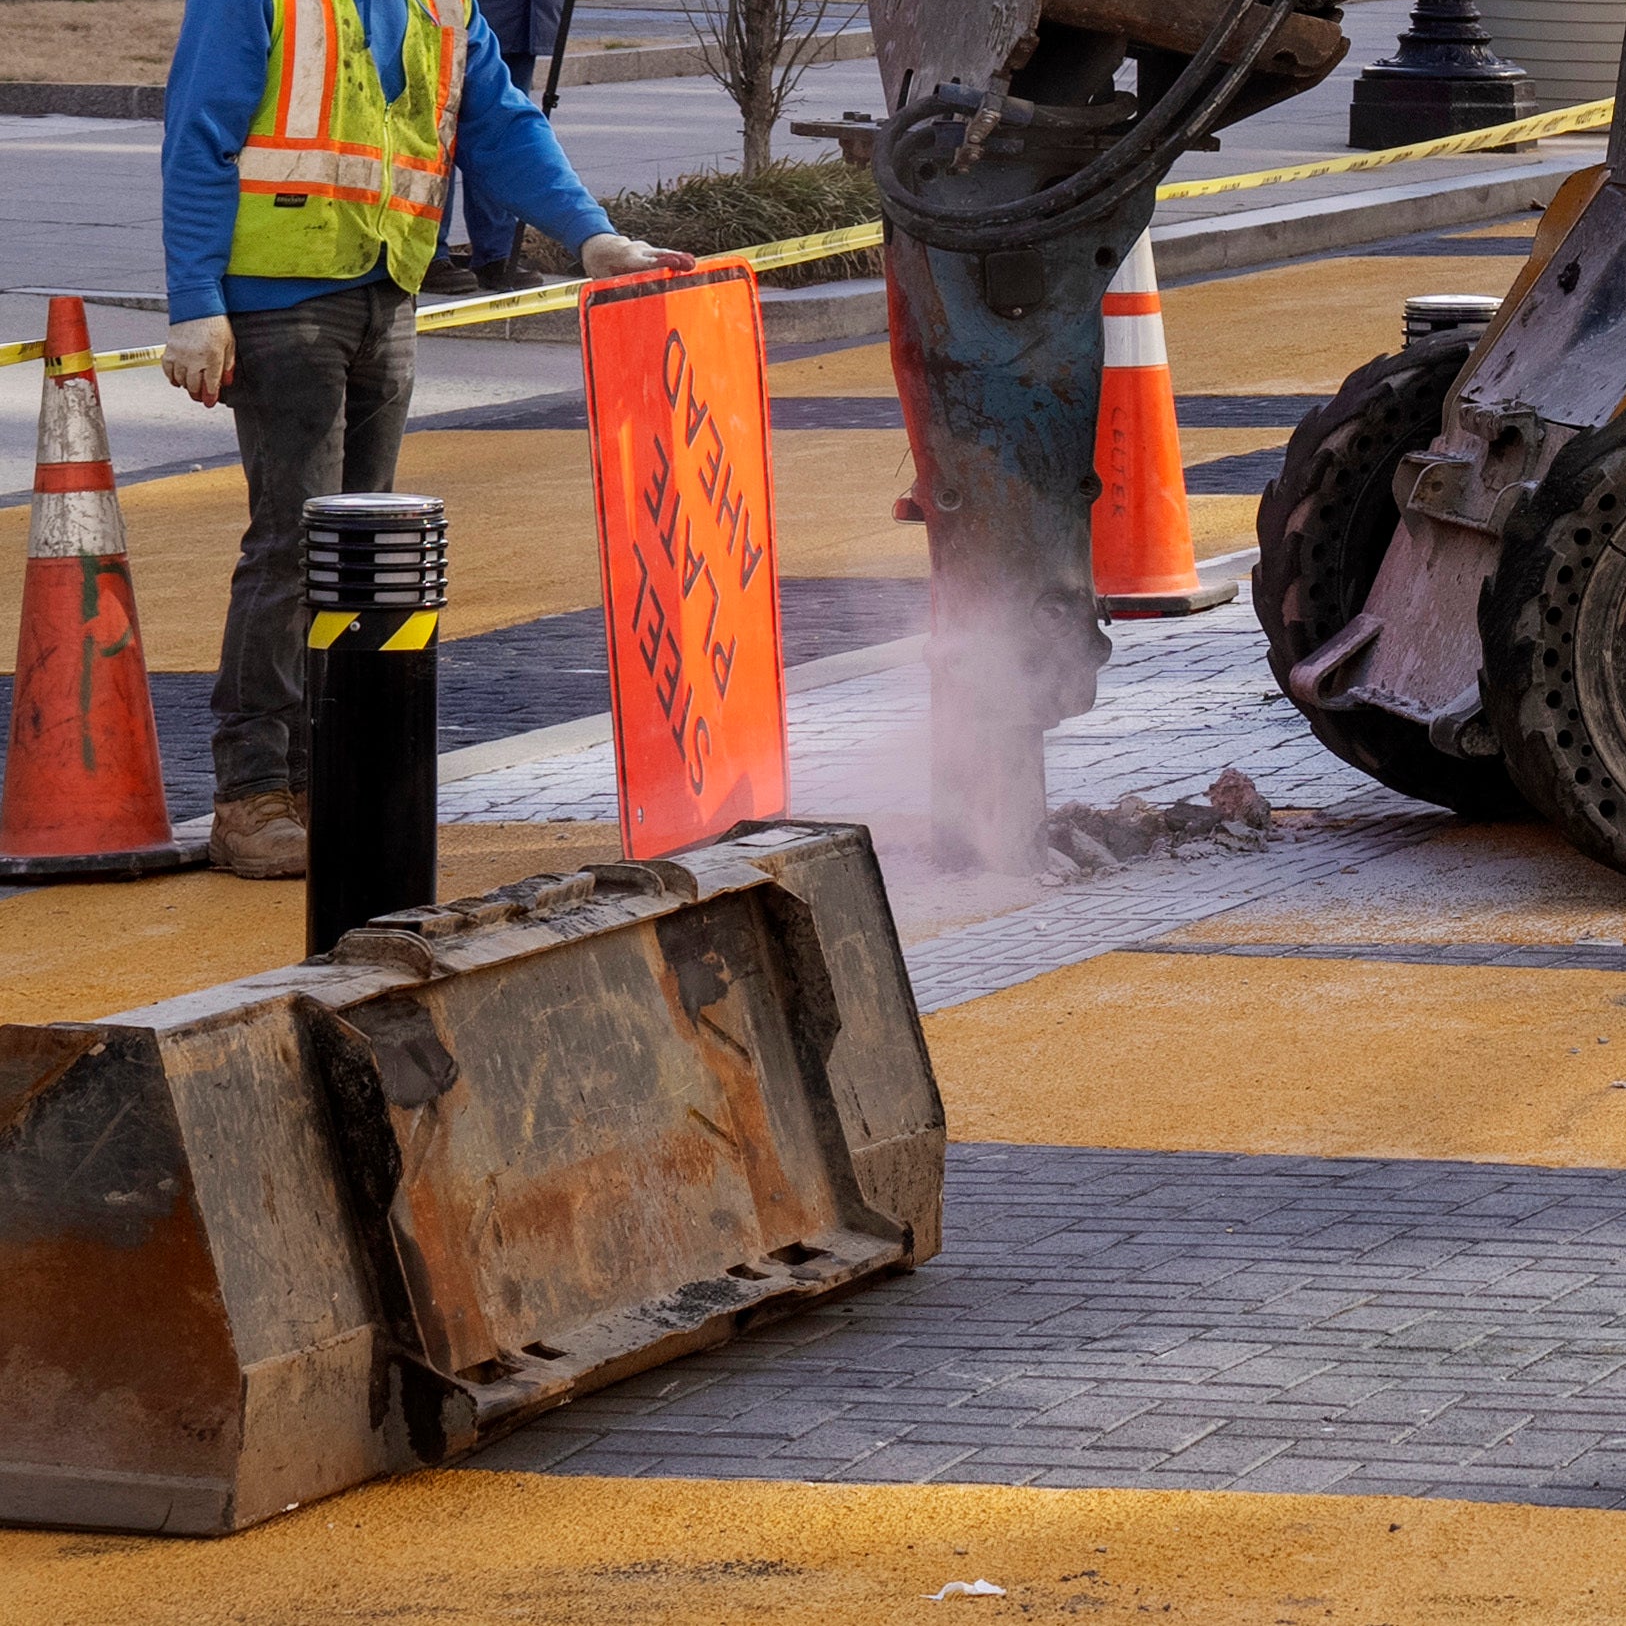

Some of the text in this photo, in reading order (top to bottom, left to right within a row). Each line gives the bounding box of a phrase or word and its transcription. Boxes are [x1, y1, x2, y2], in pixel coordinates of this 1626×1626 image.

[643, 434, 738, 703] PLATE
[661, 328, 765, 592] AHEAD
[632, 540, 713, 798] STEEL
